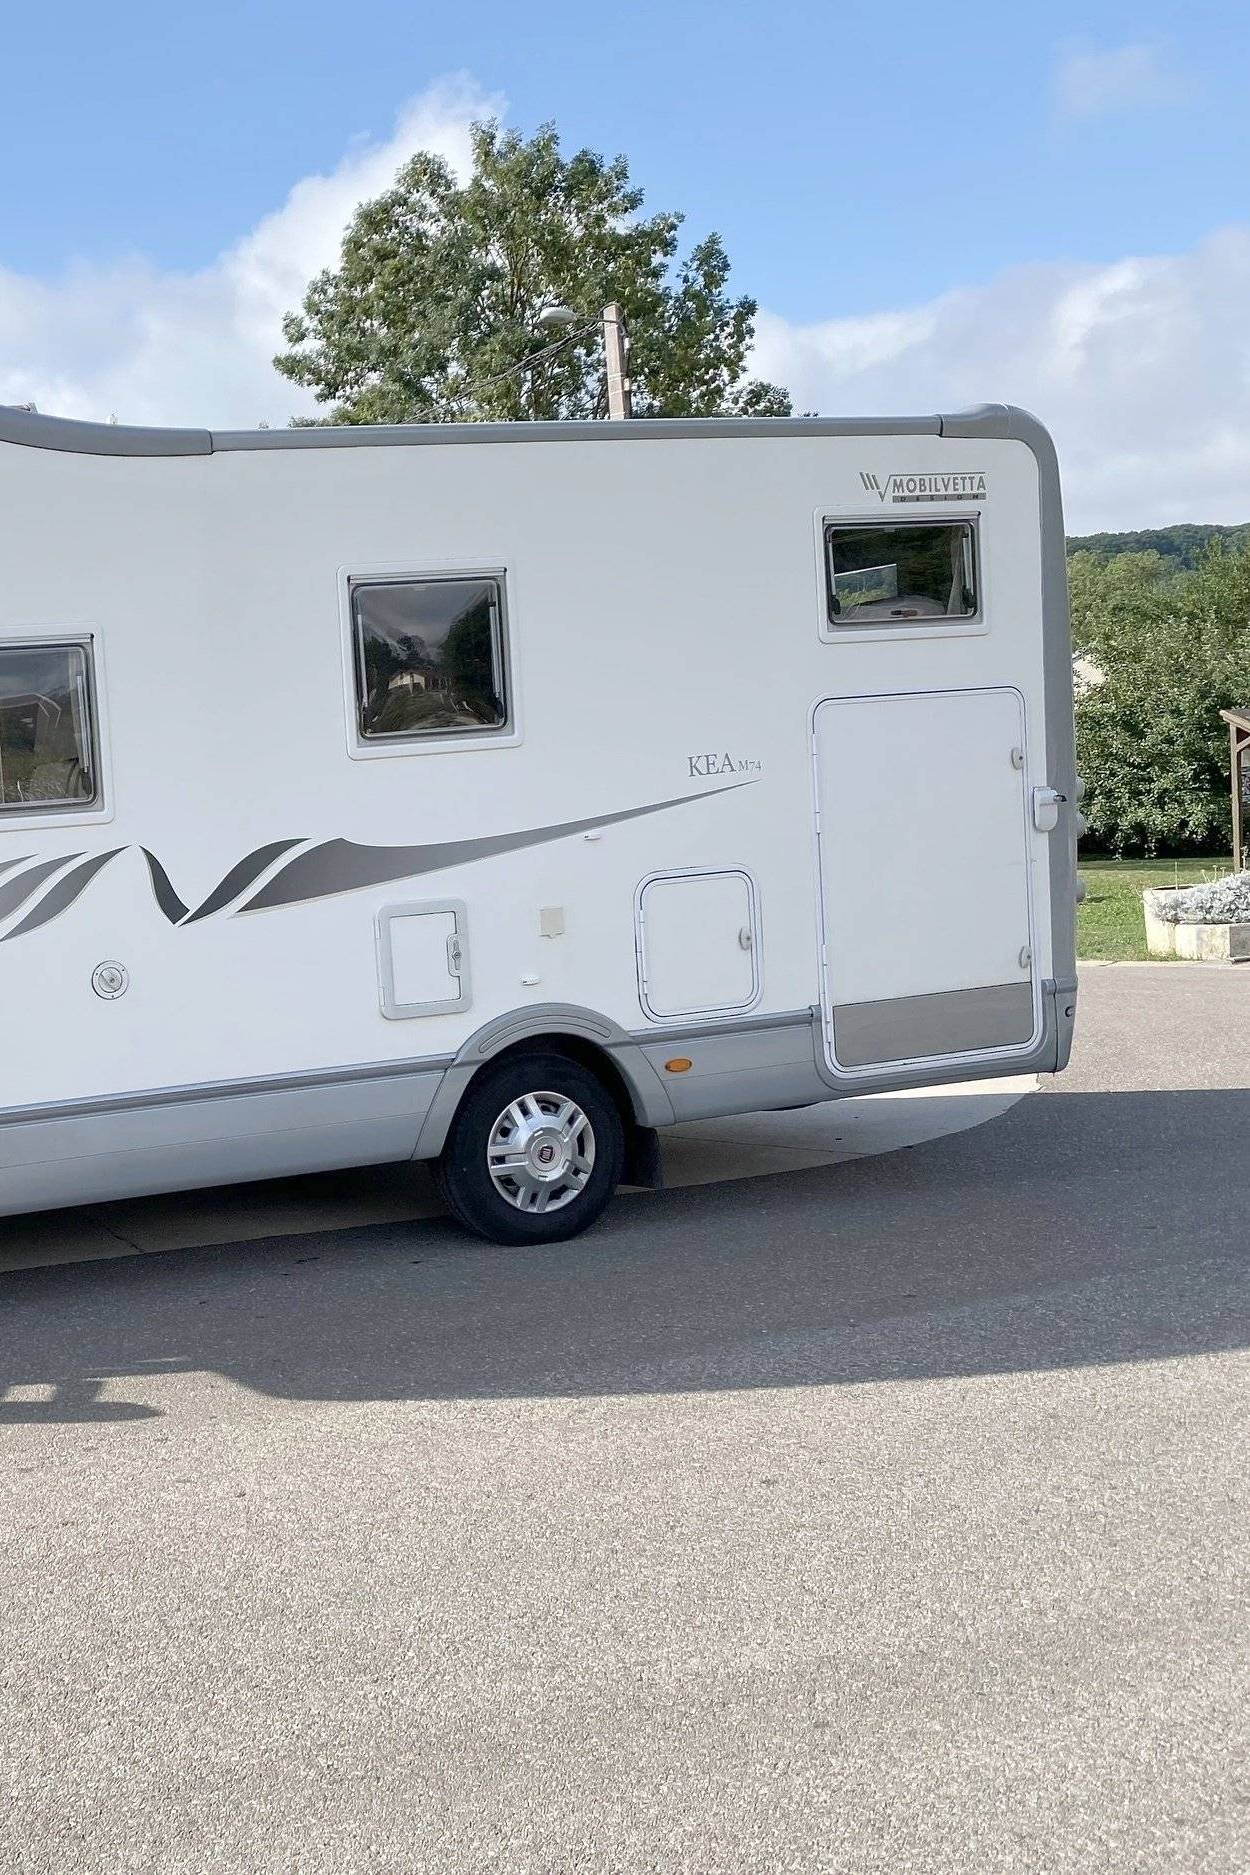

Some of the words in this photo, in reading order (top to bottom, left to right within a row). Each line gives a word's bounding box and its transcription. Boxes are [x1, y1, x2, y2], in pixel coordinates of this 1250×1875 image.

[892, 476, 986, 493] MOBILVETTA
[687, 752, 736, 777] KEA
[737, 759, 762, 772] M74
